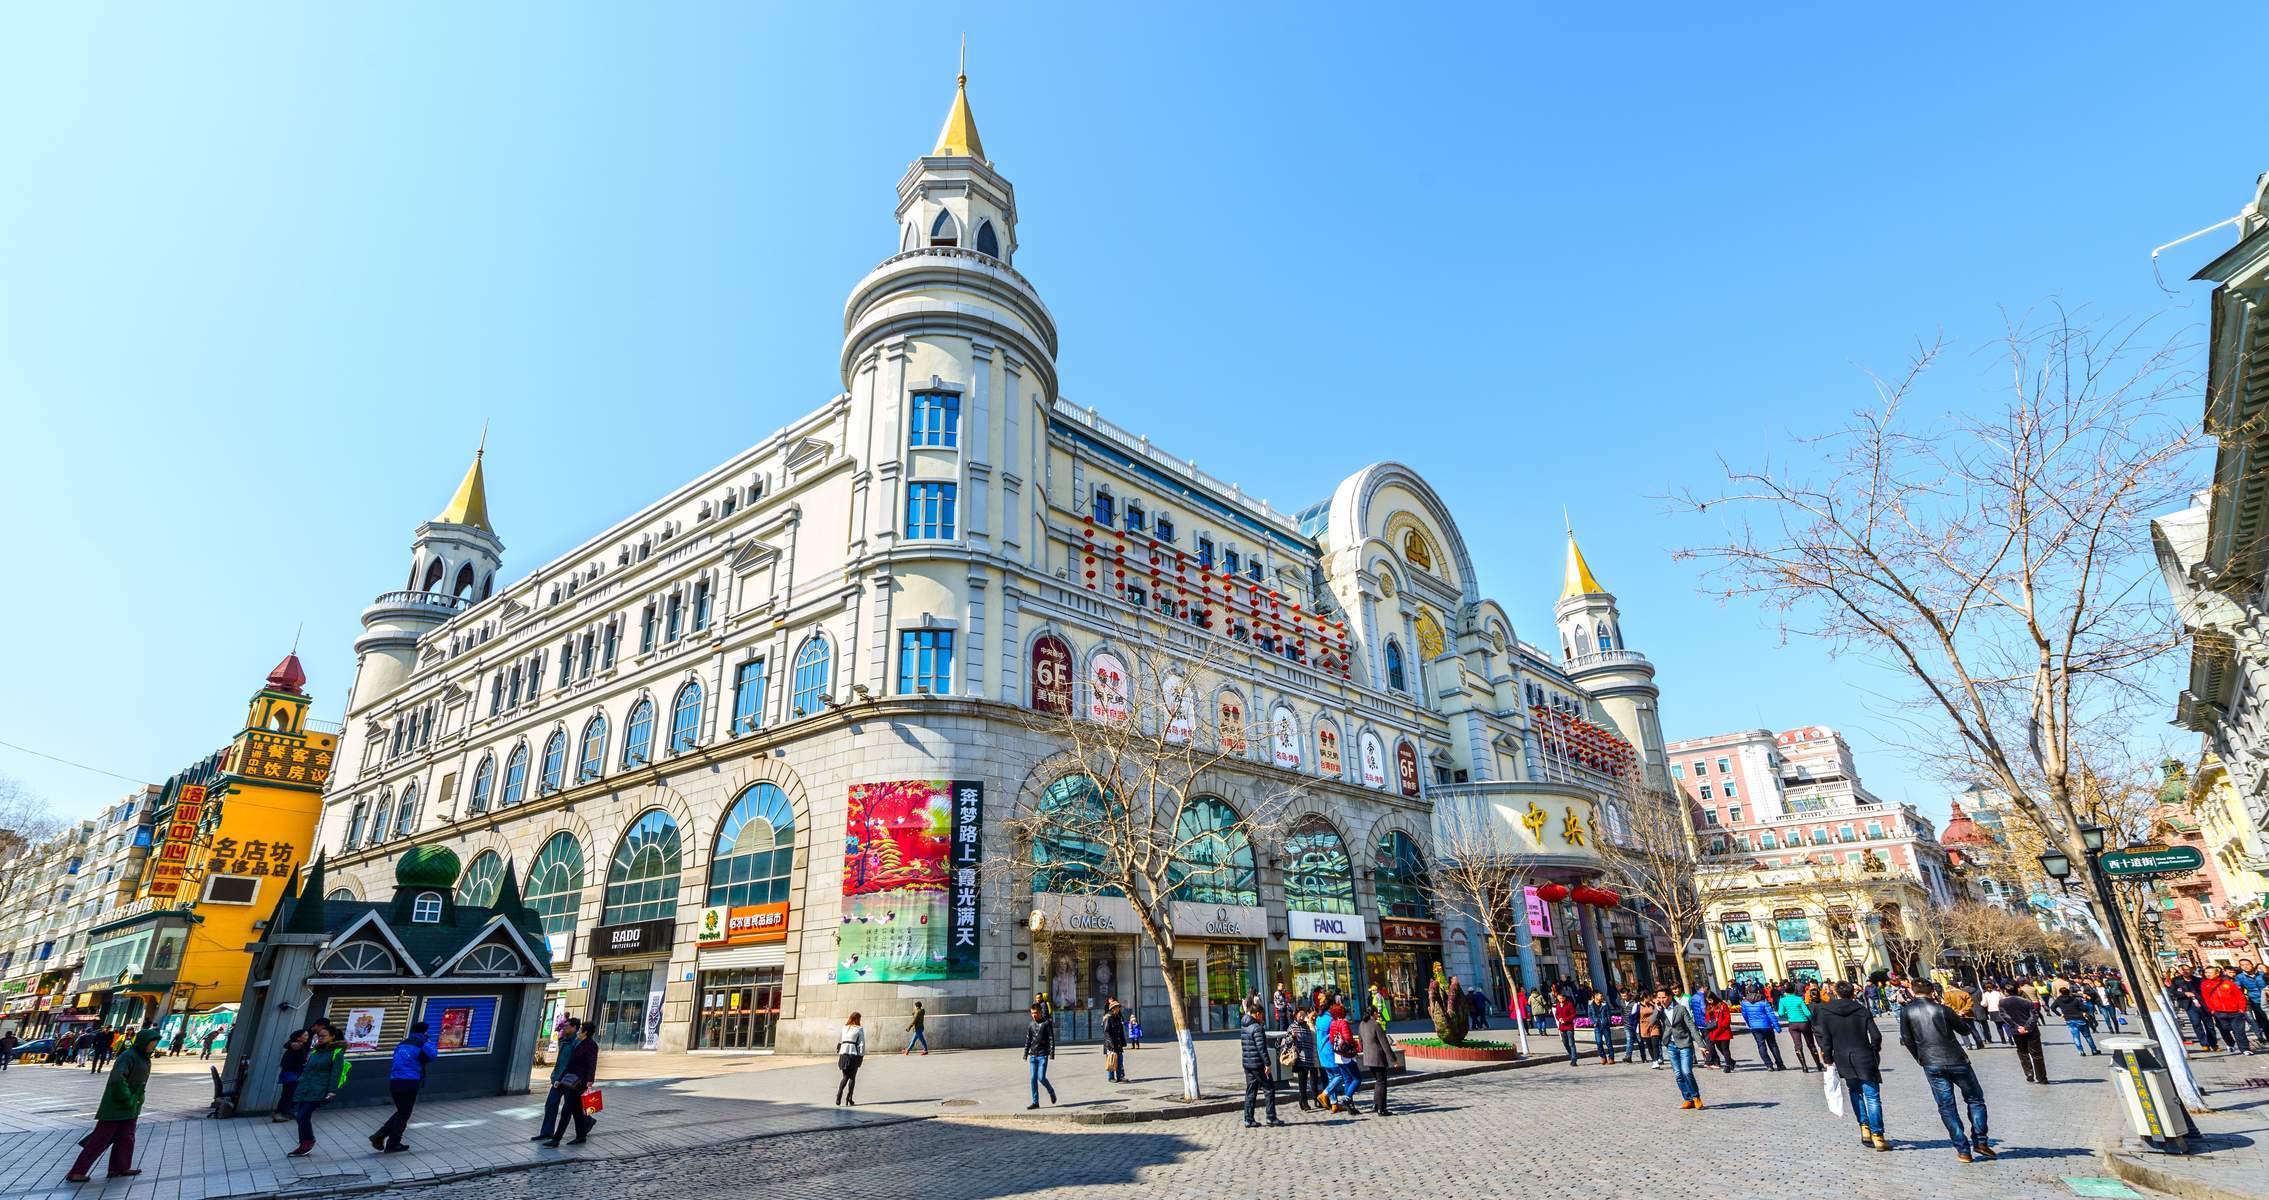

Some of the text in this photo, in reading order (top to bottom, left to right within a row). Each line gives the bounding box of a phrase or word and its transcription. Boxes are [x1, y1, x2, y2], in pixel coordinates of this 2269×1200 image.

[1037, 659, 1067, 688] 6F
[245, 741, 264, 775] 培训中心
[287, 748, 310, 780] 客房
[1400, 759, 1414, 778] 6F
[166, 786, 204, 860] 培训中心
[212, 837, 294, 863] 名店坊
[207, 858, 291, 878] 奢侈品店
[955, 788, 978, 947] 奔梦路上 霞光满天
[1069, 914, 1116, 930] OMEGA
[1205, 921, 1241, 935] OMEGA
[1314, 918, 1347, 934] FANCL
[611, 928, 641, 943] RADO
